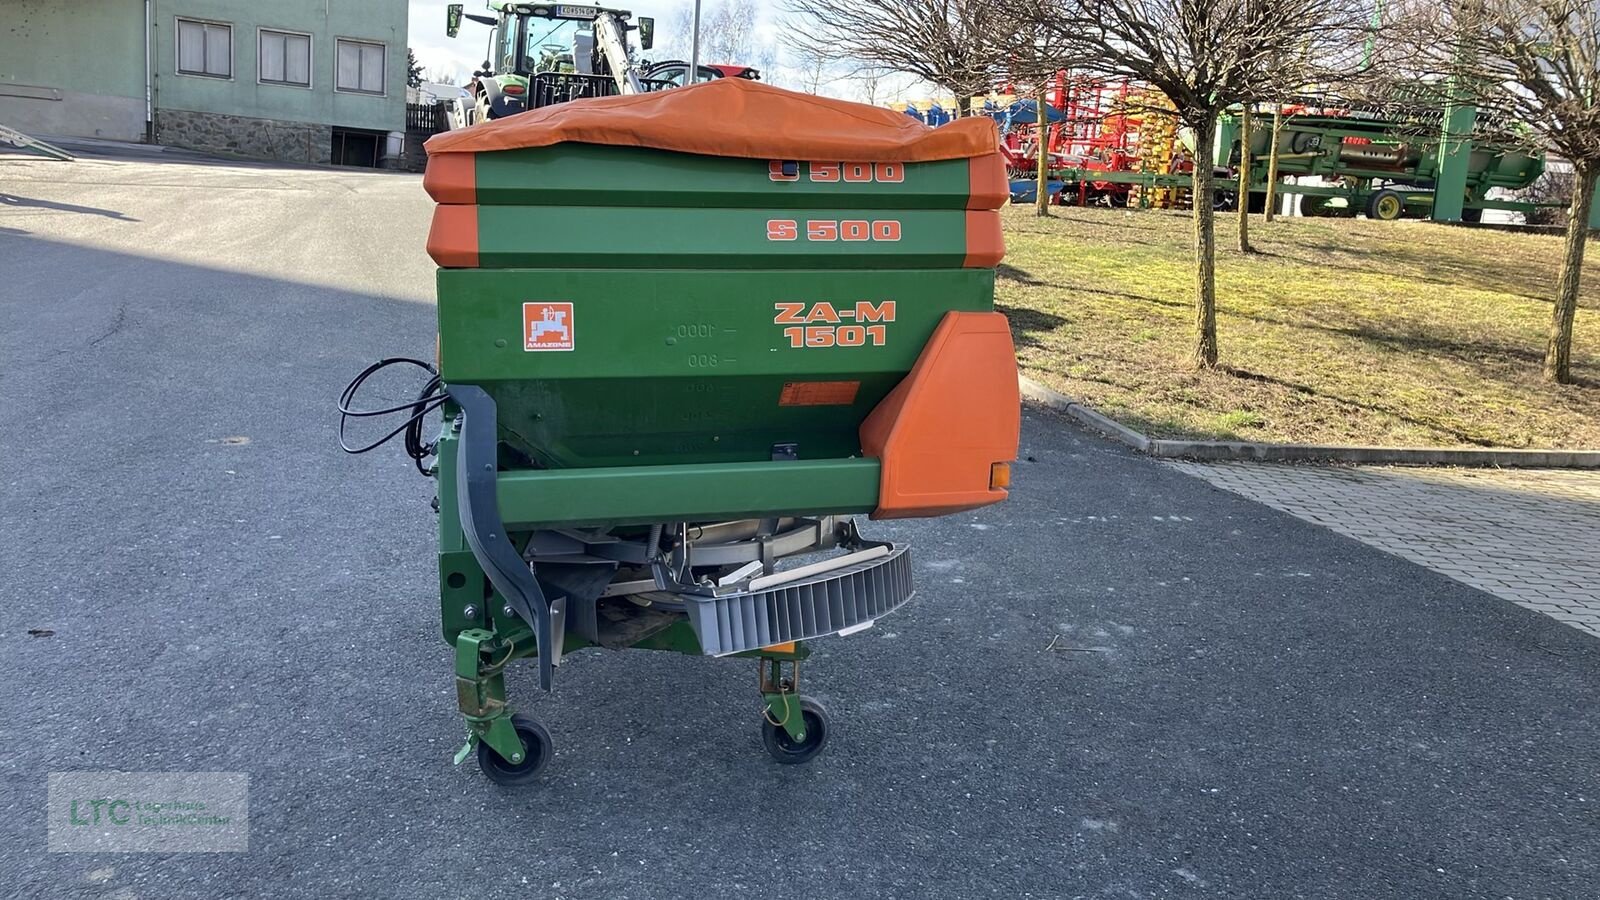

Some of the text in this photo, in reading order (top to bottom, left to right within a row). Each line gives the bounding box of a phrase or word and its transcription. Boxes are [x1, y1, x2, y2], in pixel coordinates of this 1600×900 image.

[809, 161, 905, 183] 500
[766, 219, 902, 242] S 500
[774, 300, 897, 324] ZA-M
[783, 325, 887, 348] 1501
